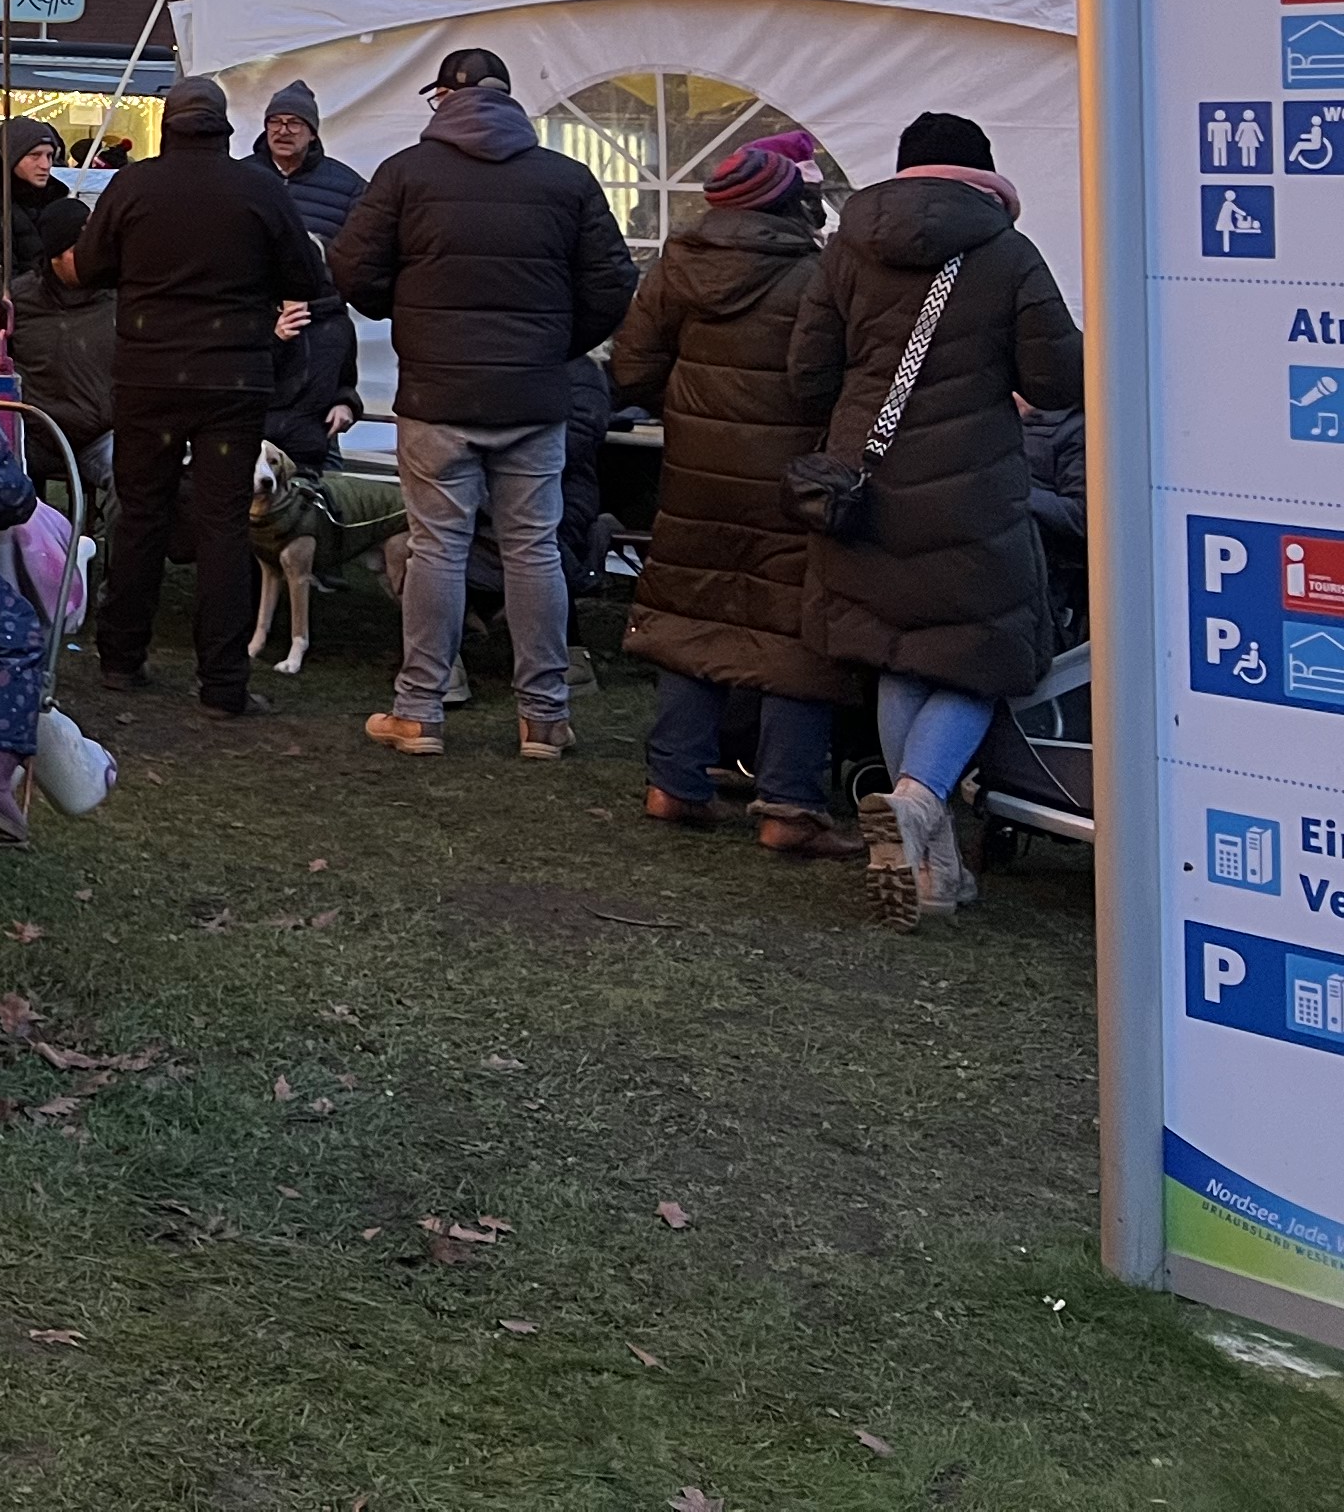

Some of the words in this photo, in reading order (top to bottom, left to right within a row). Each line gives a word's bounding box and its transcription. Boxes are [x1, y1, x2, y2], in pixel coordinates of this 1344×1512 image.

[1205, 534, 1248, 593] P
[1206, 617, 1240, 665] P
[1301, 816, 1344, 859] Ei
[1203, 942, 1246, 1004] P
[1202, 1200, 1291, 1250] URLAUBSLAND
[1206, 1178, 1282, 1230] Nordsee,
[1286, 1217, 1332, 1251] Jade,
